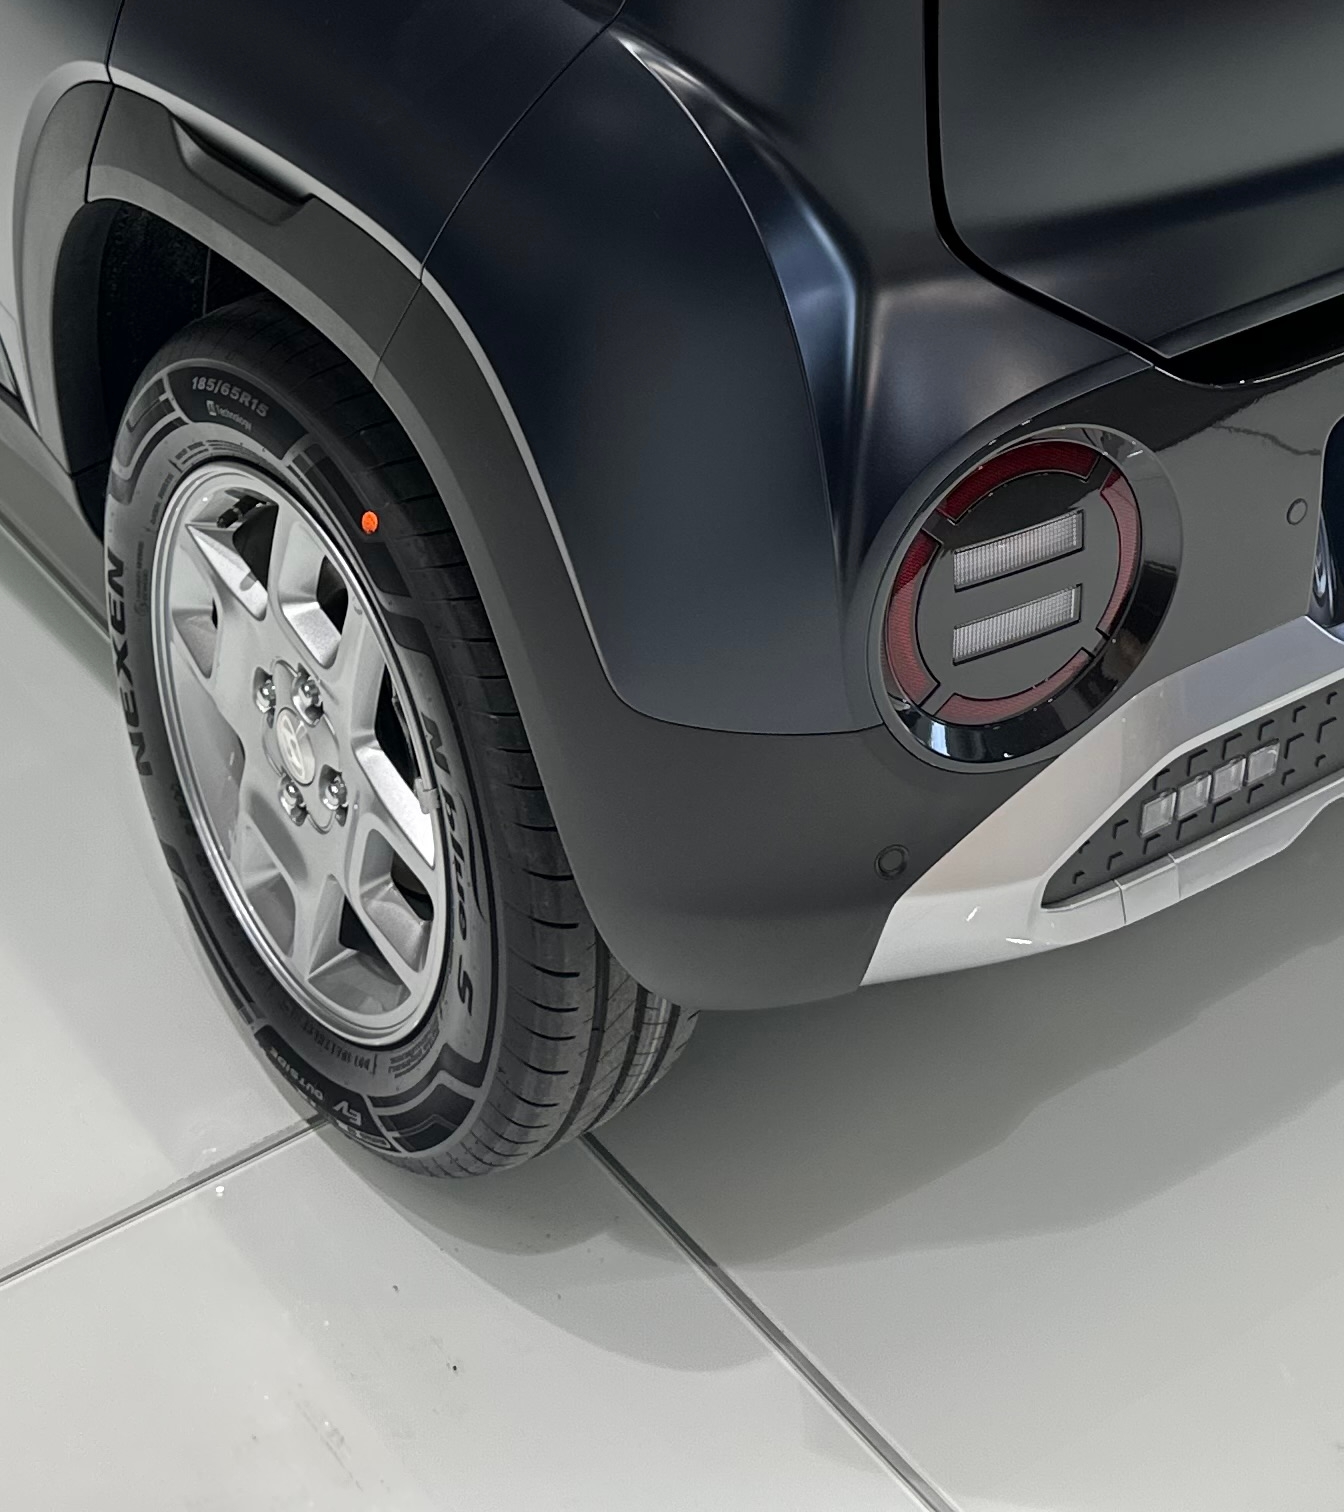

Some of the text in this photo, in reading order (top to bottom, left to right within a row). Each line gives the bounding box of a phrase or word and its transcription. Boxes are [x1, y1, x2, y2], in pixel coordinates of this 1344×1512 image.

[191, 375, 270, 418] 185/65R15
[107, 546, 153, 776] NEXEN
[457, 954, 473, 1017] S
[268, 1046, 363, 1127] EV OUTSIDE
